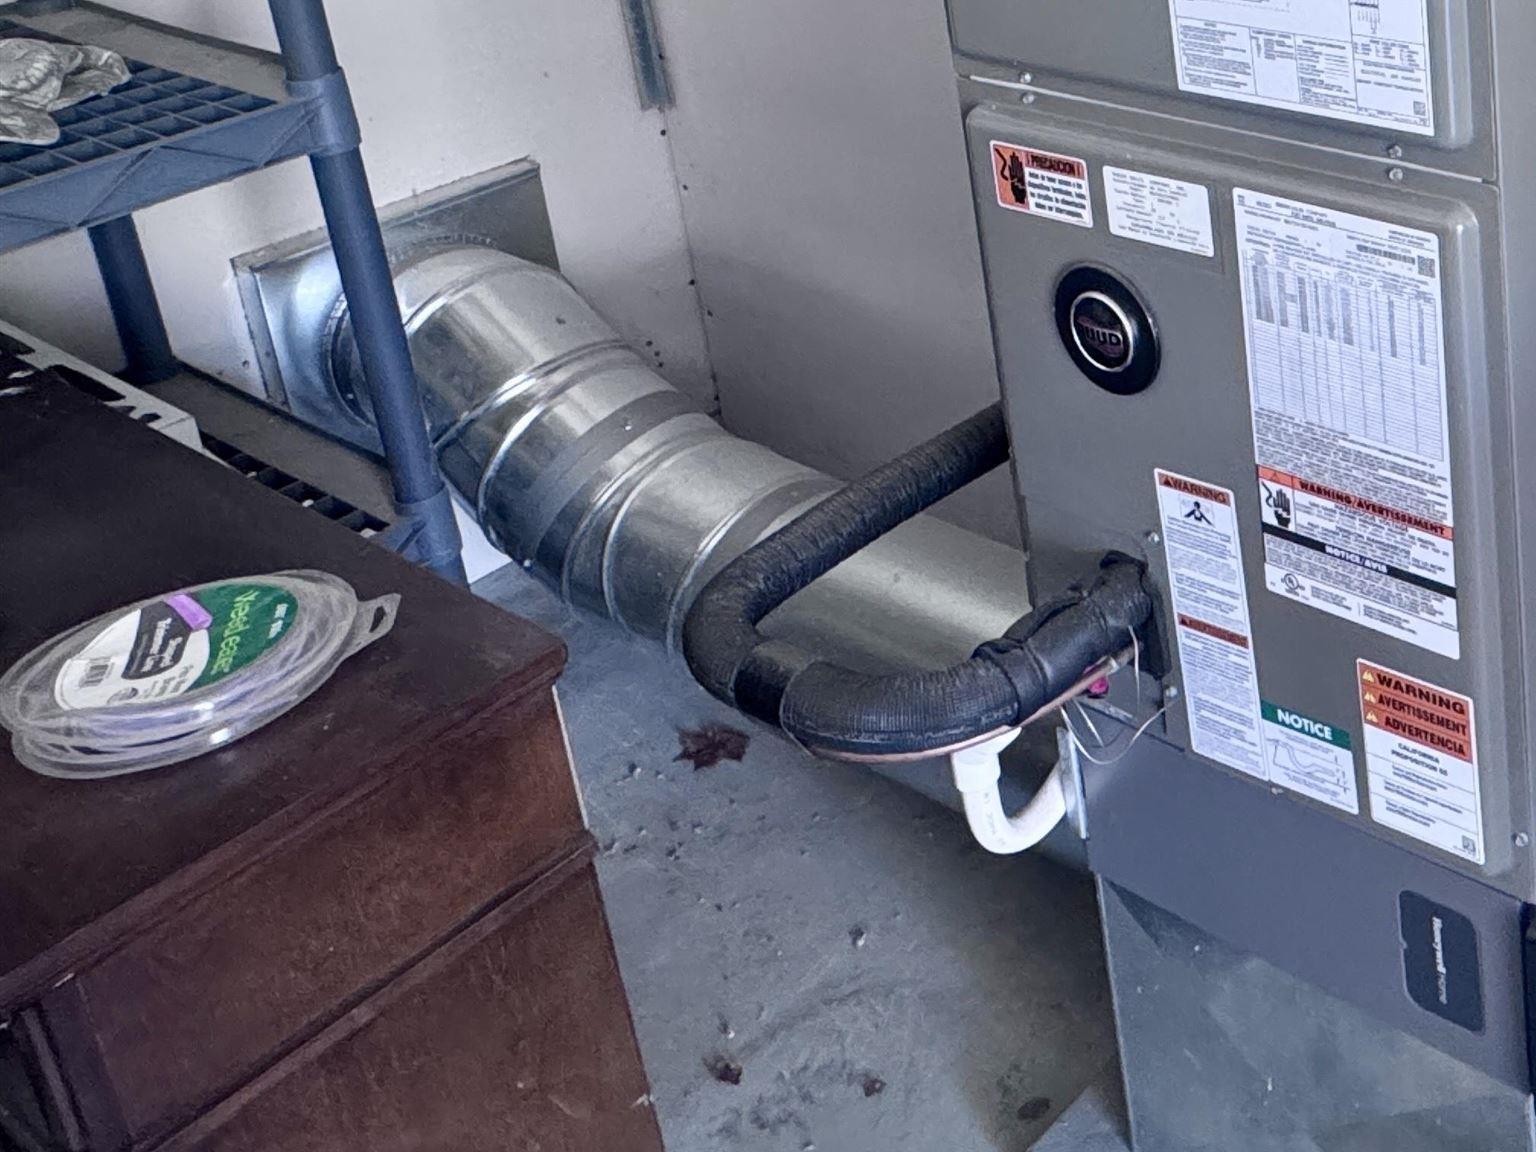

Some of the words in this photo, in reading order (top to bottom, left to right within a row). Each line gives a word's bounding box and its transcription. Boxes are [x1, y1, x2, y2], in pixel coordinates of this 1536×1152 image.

[1172, 480, 1226, 504] WARNING
[1377, 673, 1465, 715] WARNING
[1277, 709, 1333, 740] NOTICE
[1378, 694, 1467, 736] AVERTISSEMENT
[1385, 716, 1465, 756] ADVERTENCIA
